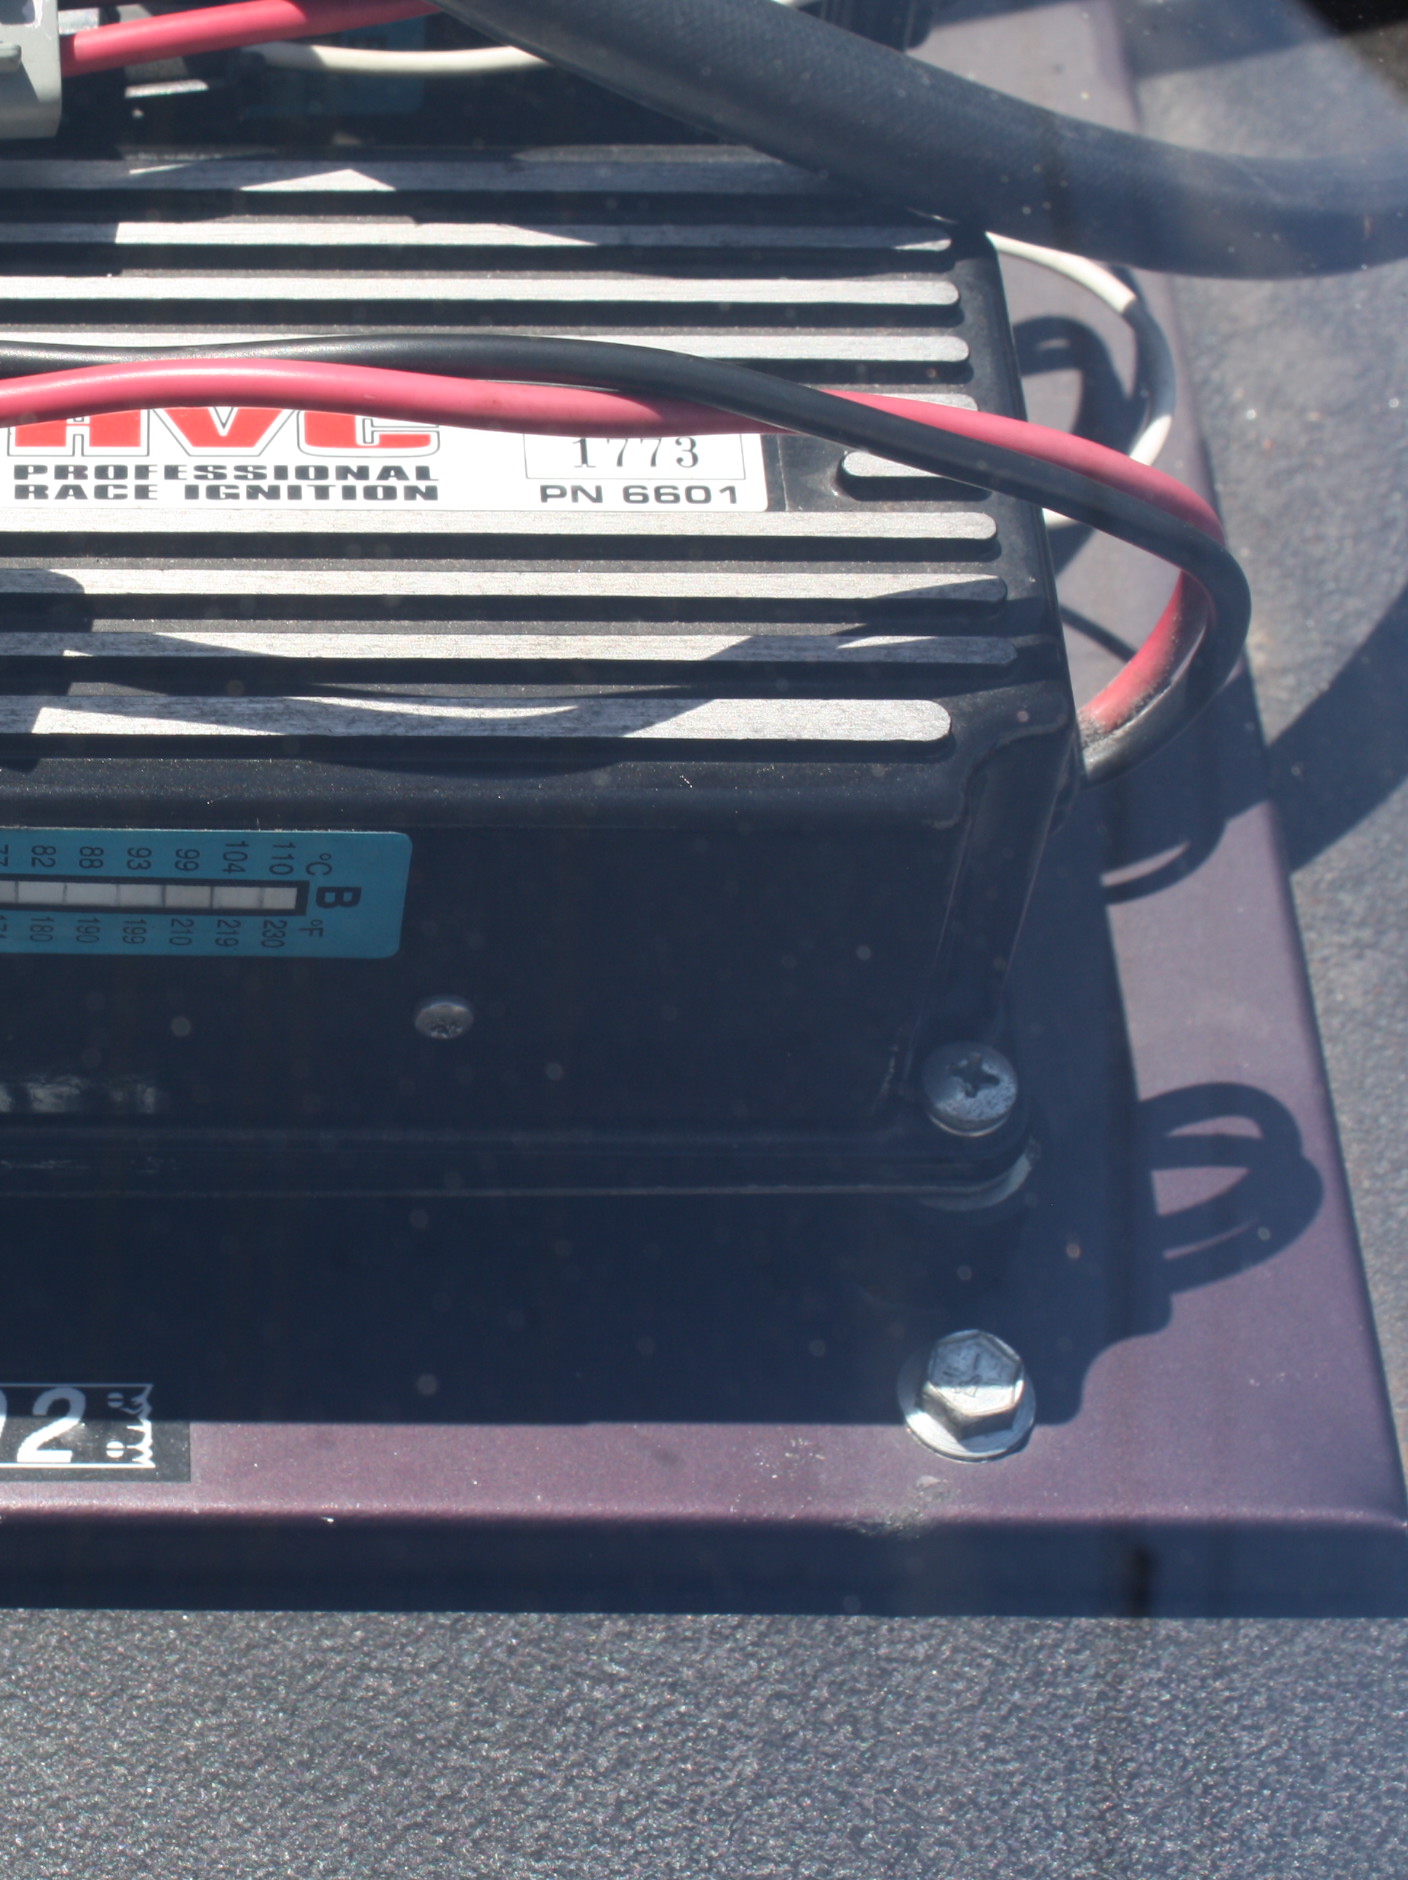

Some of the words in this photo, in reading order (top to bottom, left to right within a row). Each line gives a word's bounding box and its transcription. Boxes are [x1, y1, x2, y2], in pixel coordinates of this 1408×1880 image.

[572, 435, 699, 468] 1773
[13, 464, 440, 481] PROFESSIONAL
[14, 484, 159, 500] RACE
[184, 484, 439, 501] IGNITION
[540, 485, 603, 503] PN
[622, 485, 737, 504] 6601
[31, 845, 57, 868] 82
[78, 846, 104, 869] 88
[126, 847, 152, 870] 93
[174, 849, 200, 872] 99
[222, 841, 249, 874] 104
[269, 842, 296, 876] 110
[315, 886, 362, 909] B
[29, 916, 55, 943] 180
[75, 917, 101, 944] 190
[122, 919, 147, 945] 199
[169, 918, 195, 946] 210
[215, 919, 241, 947] 219
[261, 919, 287, 948] 230
